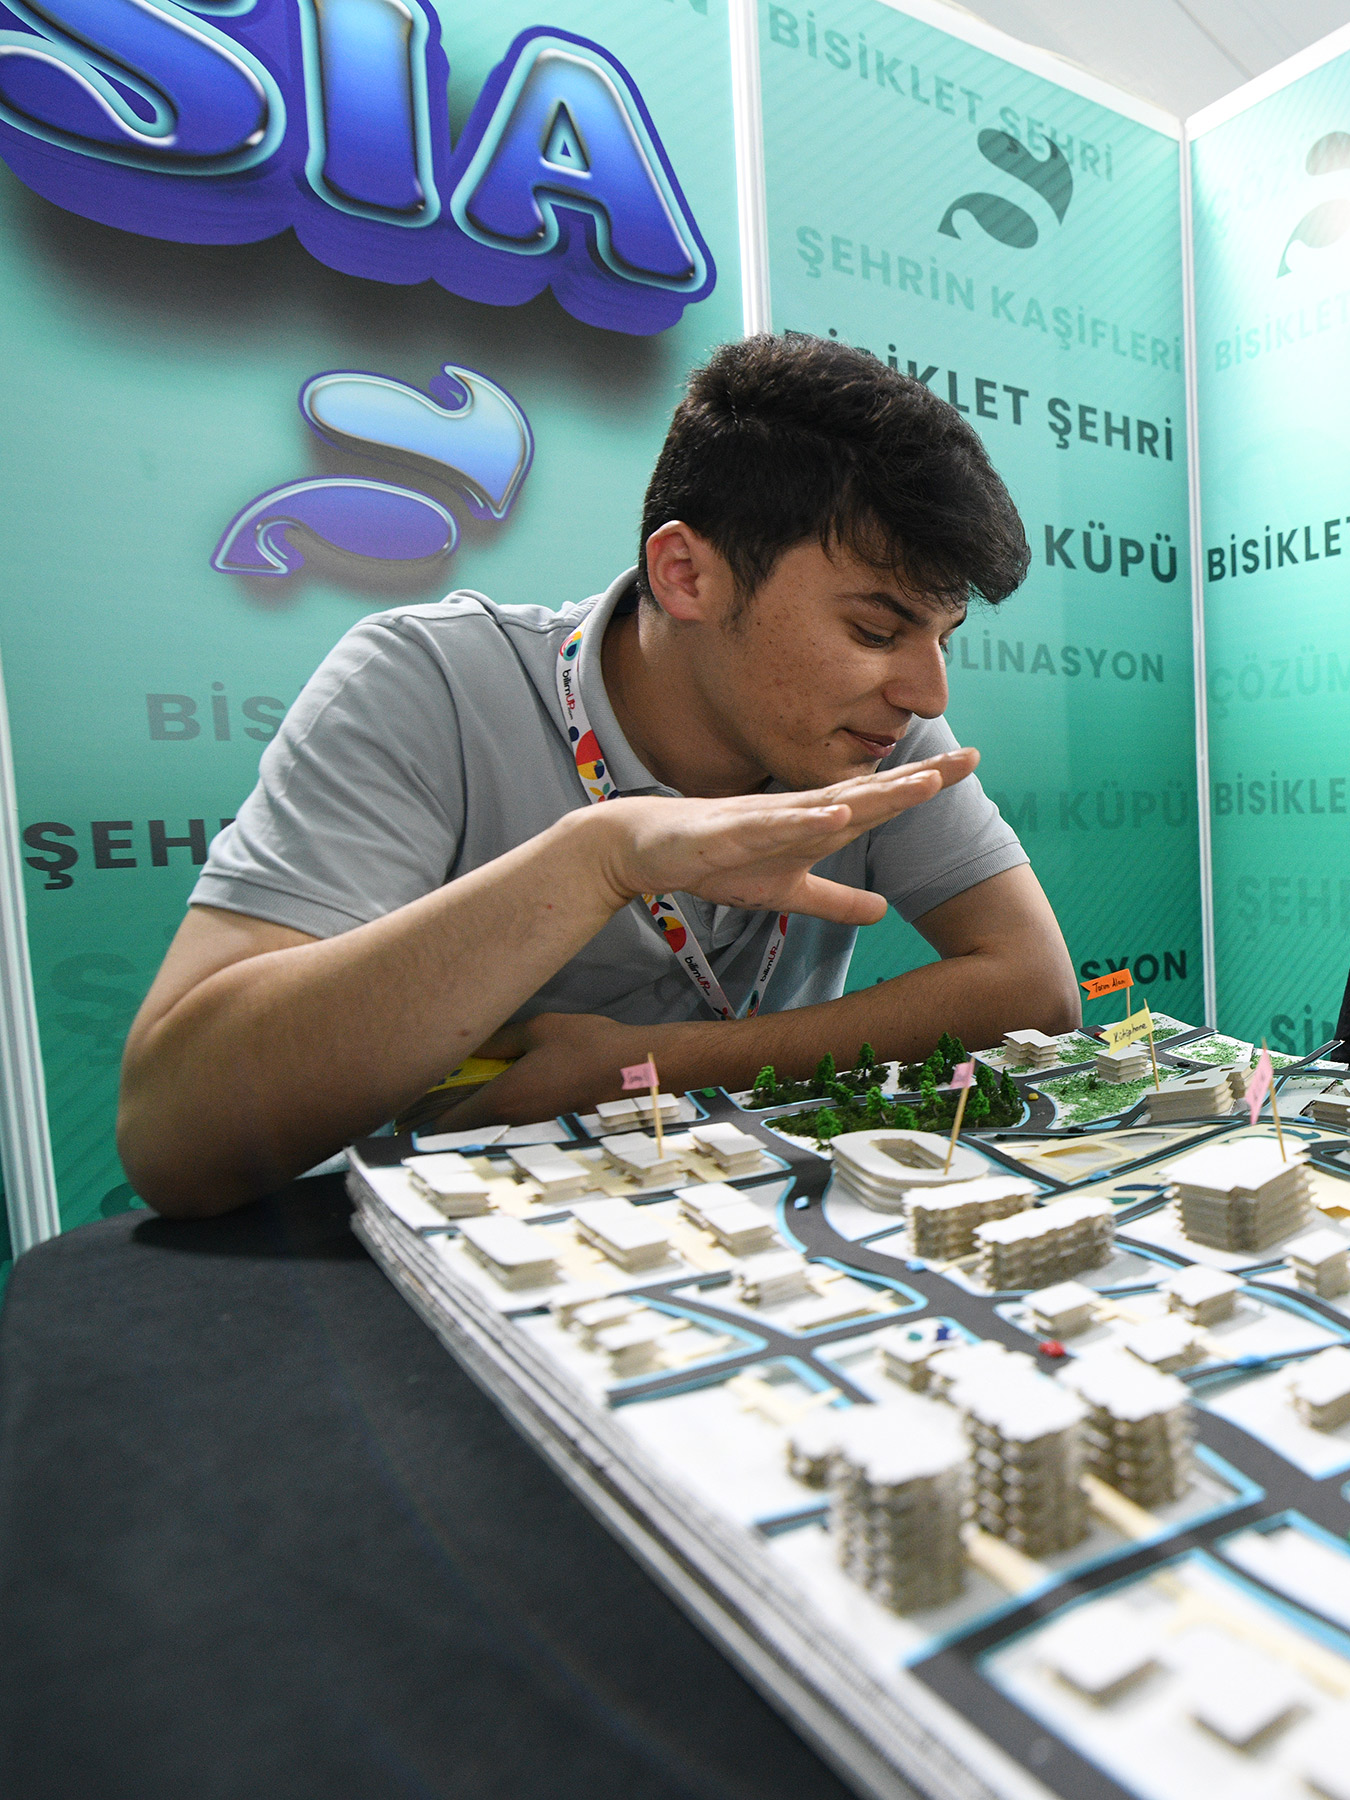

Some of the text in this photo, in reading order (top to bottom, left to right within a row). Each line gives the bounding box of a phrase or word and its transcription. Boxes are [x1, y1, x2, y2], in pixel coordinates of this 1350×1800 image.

[768, 2, 1114, 181] BİSİKLET ŞEHRİ
[795, 225, 1181, 374] ŞEHRİN KAŞİFLERİ
[1047, 397, 1175, 462] ŞEHRİ
[1044, 520, 1179, 585] KÜPÜ
[21, 817, 235, 892] ŞEH
